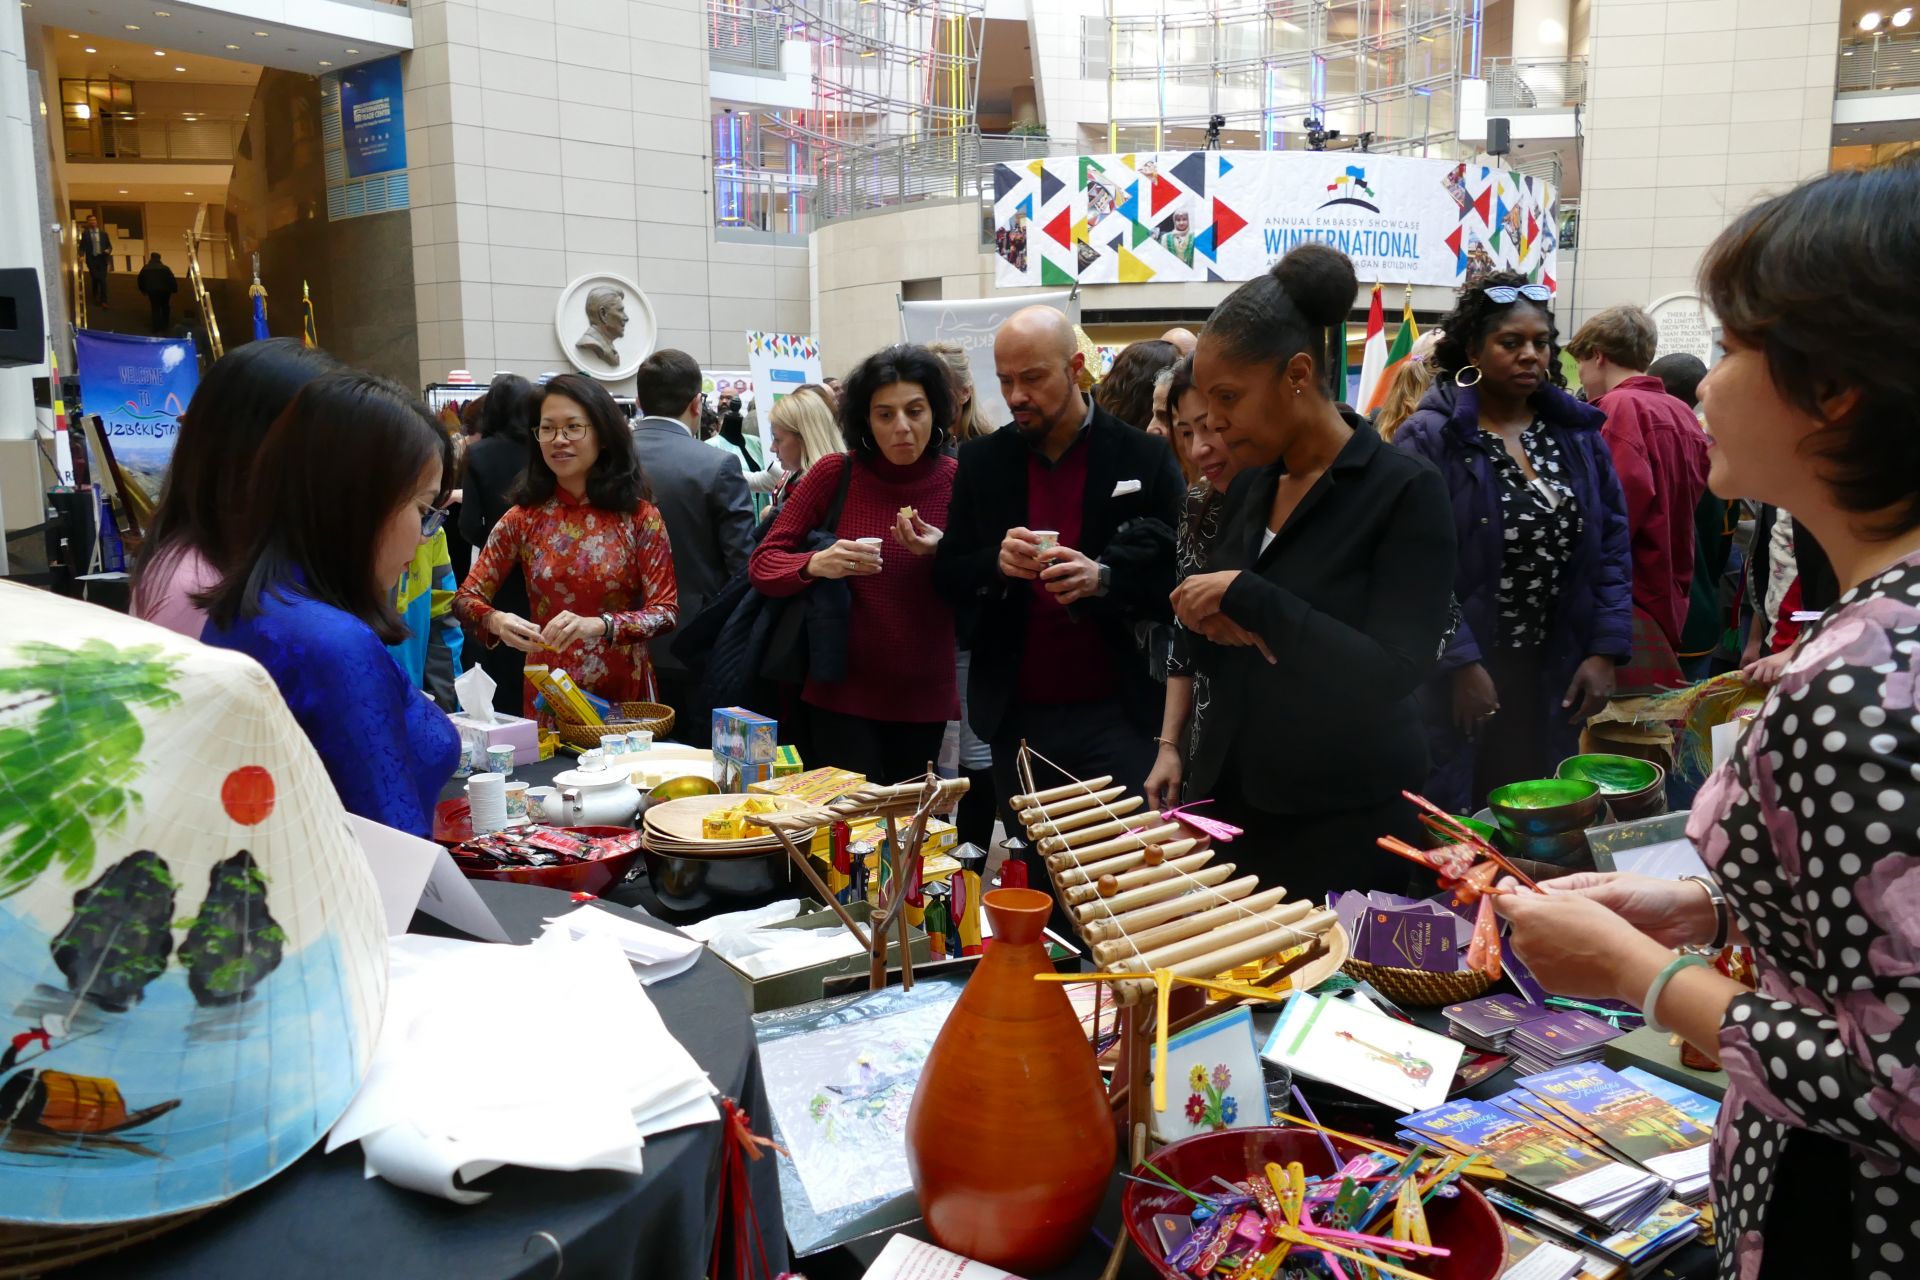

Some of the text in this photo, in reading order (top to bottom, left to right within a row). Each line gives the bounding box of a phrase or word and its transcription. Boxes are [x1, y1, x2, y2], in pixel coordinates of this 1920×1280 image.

[1264, 217, 1420, 230] ANNUAL EMBASSY SHOWCASE
[1264, 228, 1420, 259] WINTERNATIONAL
[1354, 260, 1379, 268] AGAN
[1382, 261, 1419, 271] BUILDING
[120, 367, 163, 385] WELCOME
[138, 390, 150, 407] TO
[105, 421, 180, 438] UZBEKISTA
